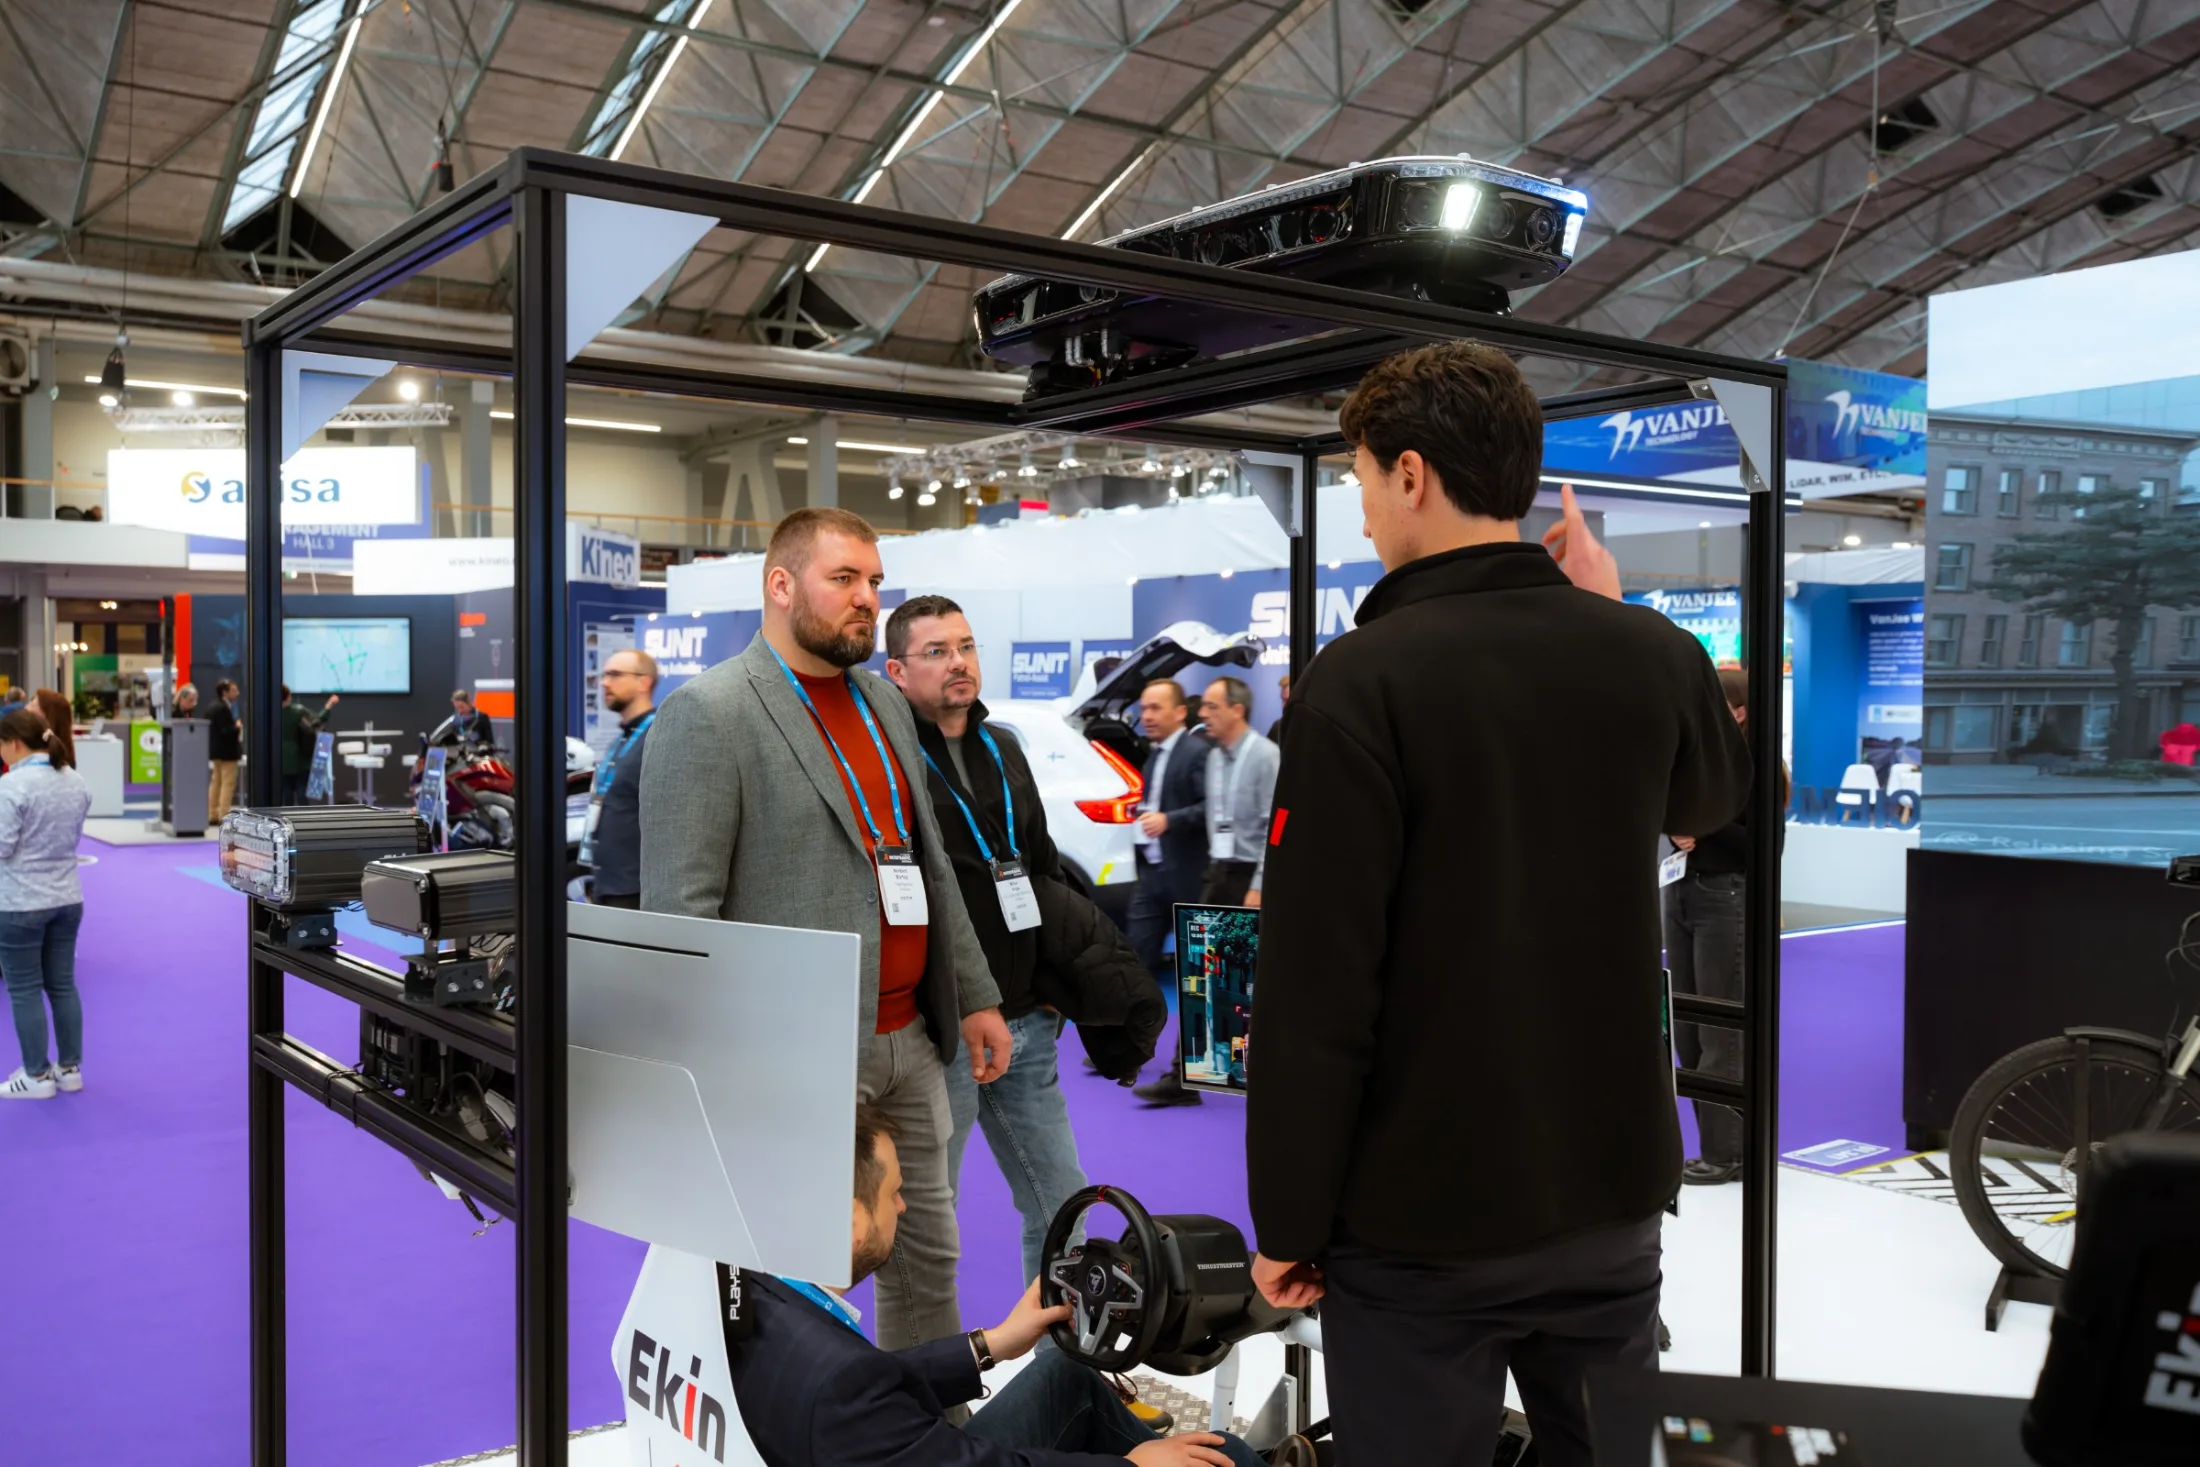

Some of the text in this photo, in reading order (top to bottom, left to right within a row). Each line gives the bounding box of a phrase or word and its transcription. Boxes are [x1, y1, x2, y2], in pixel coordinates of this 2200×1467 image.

[293, 538, 324, 550] HALL
[581, 535, 635, 581] Kineo
[1248, 585, 1374, 638] SN
[1671, 592, 1736, 608] VANJEE
[644, 626, 708, 660] SUNIT
[1012, 652, 1069, 674] SUNIT
[1992, 835, 2128, 859] Relaxing
[1197, 1262, 1245, 1270] THRUSTMASTER
[2143, 1281, 2200, 1416] Eki
[628, 1329, 726, 1465] Ekin
